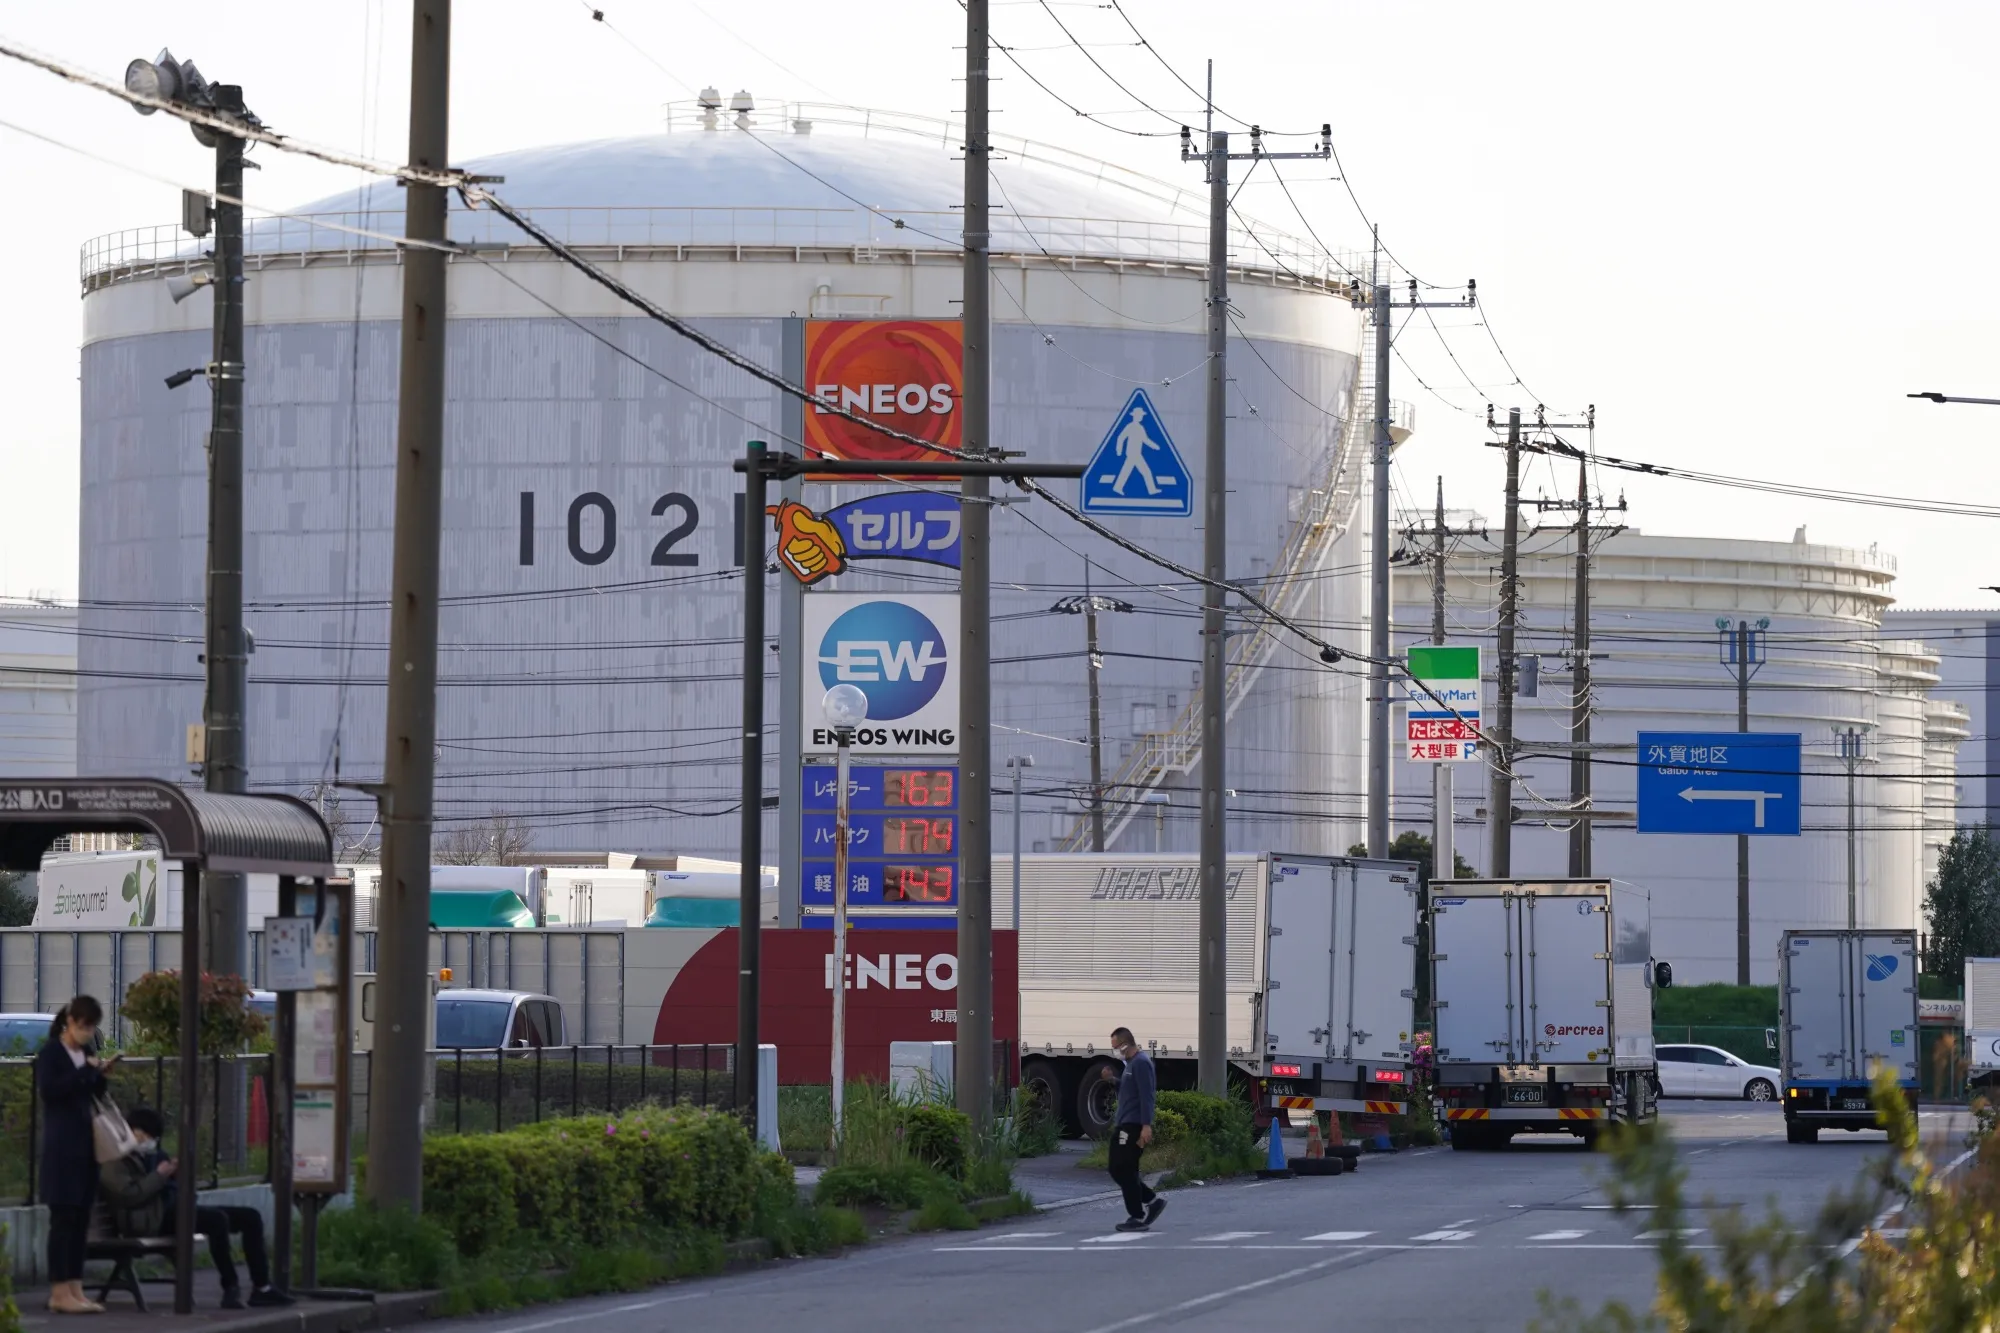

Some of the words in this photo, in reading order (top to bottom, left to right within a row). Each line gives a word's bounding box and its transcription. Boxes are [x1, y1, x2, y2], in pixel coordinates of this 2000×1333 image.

[815, 384, 953, 415] ENEOS
[520, 491, 746, 567] 1021
[847, 509, 961, 551] セルフ
[837, 640, 934, 682] EW
[813, 728, 888, 746] ENEOS
[892, 728, 955, 746] WING
[1412, 743, 1458, 758] 大型車
[1464, 742, 1477, 759] P
[1648, 745, 1729, 764] 外貿地区
[814, 780, 871, 797] レギラー
[900, 772, 953, 806] 163
[900, 819, 953, 851] 174
[900, 867, 953, 901] 143
[1091, 868, 1245, 899] URASHIA
[825, 953, 958, 991] ENEO
[930, 1009, 958, 1023] 東扇
[1557, 1025, 1604, 1036] arcrea
[1514, 1091, 1540, 1101] 66-00
